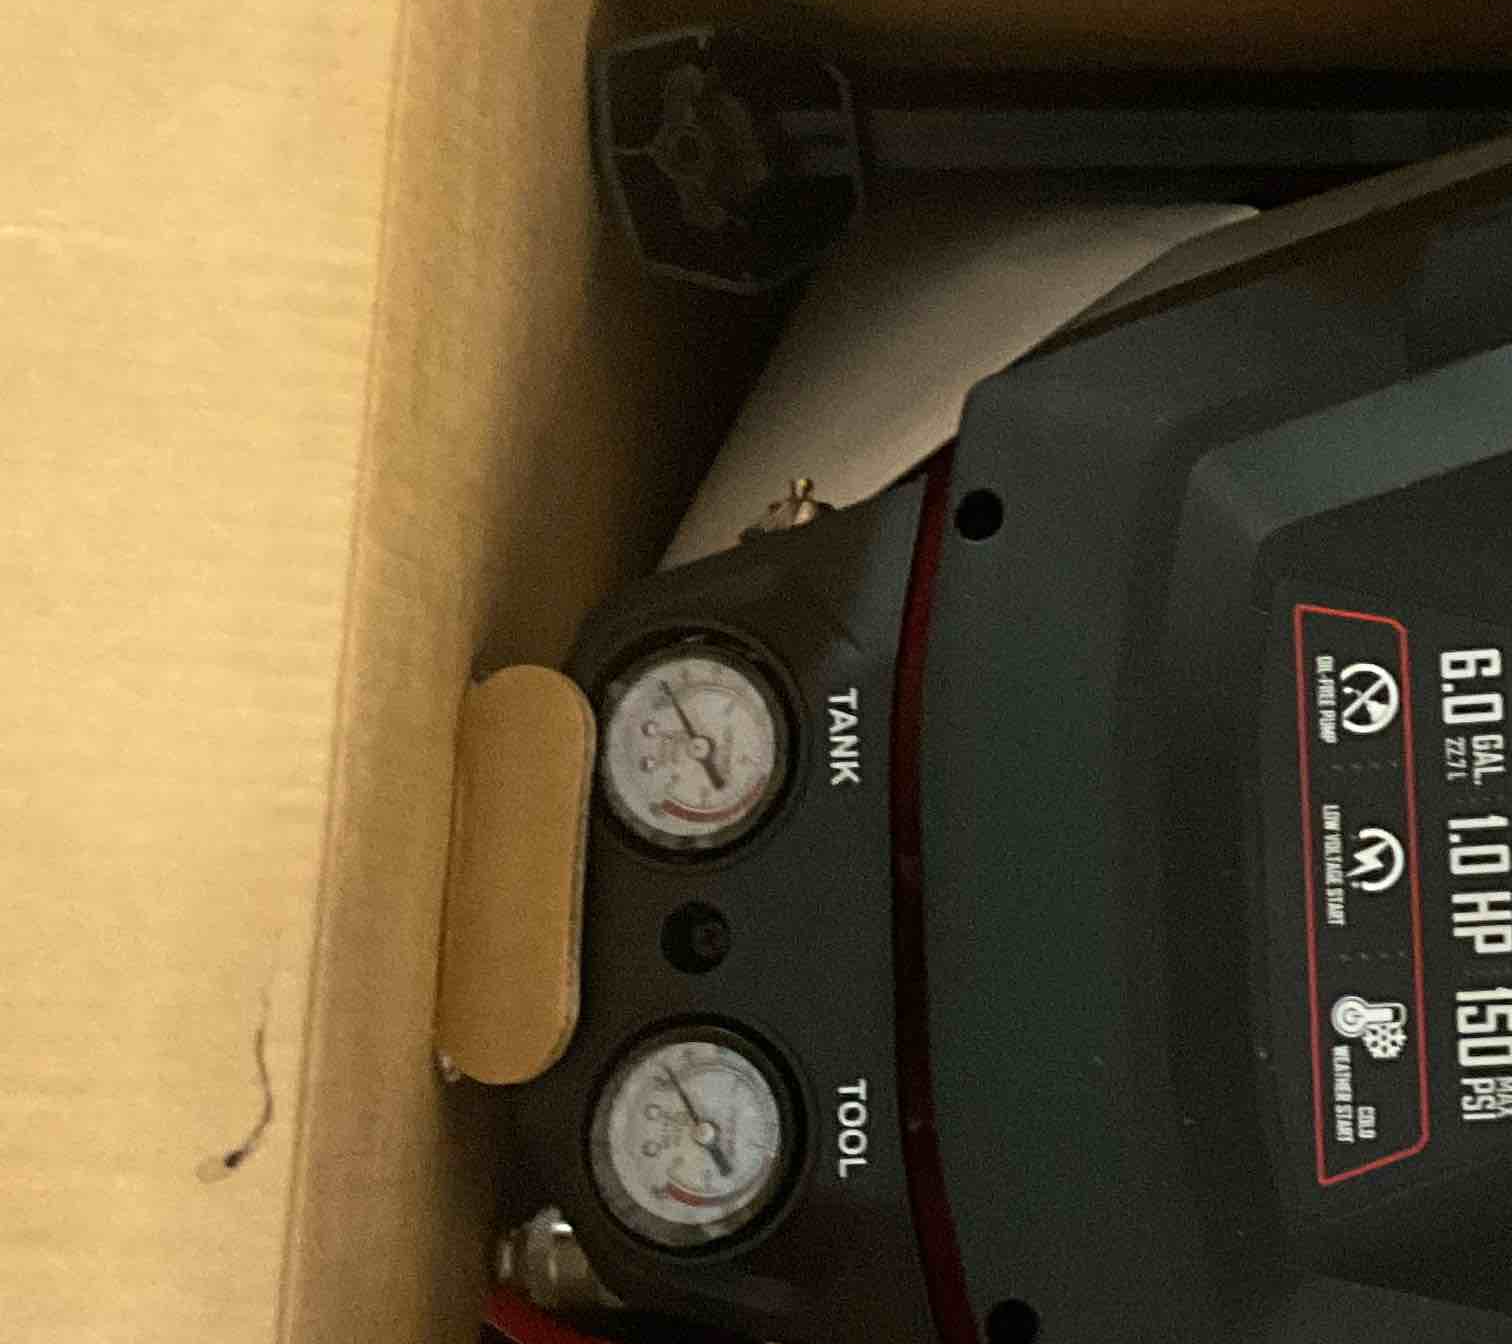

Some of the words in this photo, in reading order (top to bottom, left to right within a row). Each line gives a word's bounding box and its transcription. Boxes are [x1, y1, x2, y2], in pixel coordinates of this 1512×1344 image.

[1315, 655, 1337, 707] OIL-FREE
[1440, 648, 1503, 725] 6.0
[828, 687, 860, 786] TANK
[1318, 709, 1339, 744] PUMP
[1471, 734, 1506, 785] GAL.
[1322, 805, 1342, 832] LOW
[1323, 833, 1345, 885] VOLTAGE
[1448, 815, 1512, 875] 1.0
[1325, 887, 1347, 926] START
[1332, 1046, 1353, 1102] WEATHER
[1460, 1078, 1497, 1120] PSI
[835, 1077, 870, 1178] TOOL
[1335, 1104, 1356, 1143] START
[1357, 1106, 1377, 1140] COLD
